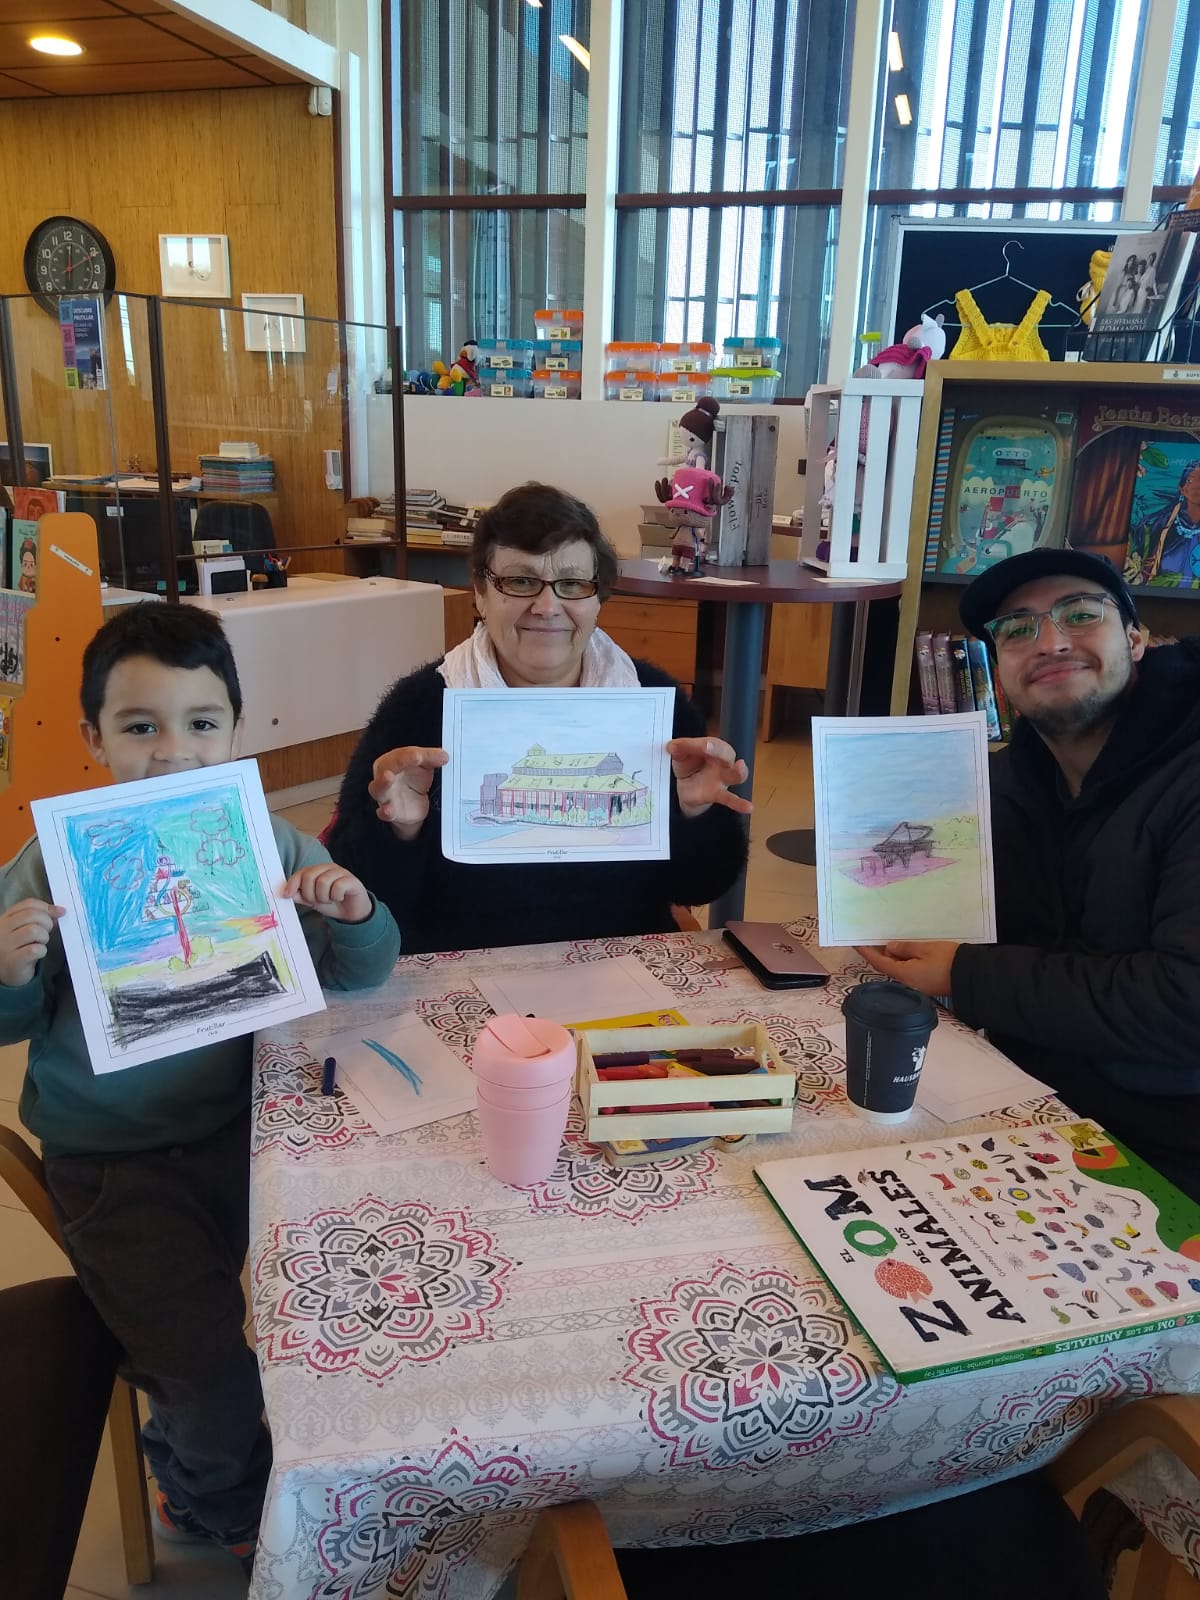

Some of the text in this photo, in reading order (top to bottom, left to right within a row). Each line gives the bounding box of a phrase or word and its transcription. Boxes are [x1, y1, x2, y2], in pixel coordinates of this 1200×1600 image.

[52, 235, 58, 245] 11
[64, 231, 72, 240] 12
[42, 248, 51, 258] 10
[41, 265, 47, 275] 9
[94, 264, 100, 274] 3
[46, 282, 52, 291] 8
[92, 281, 98, 289] 4
[995, 450, 1029, 458] OTTO
[964, 486, 1048, 498] AEROPUERTO
[867, 1169, 1026, 1323] ANIMALES
[894, 1226, 932, 1265] DE LOS
[839, 1248, 855, 1264] EL
[1126, 1328, 1142, 1336] LOS
[1055, 1329, 1124, 1353] ANIMALES
